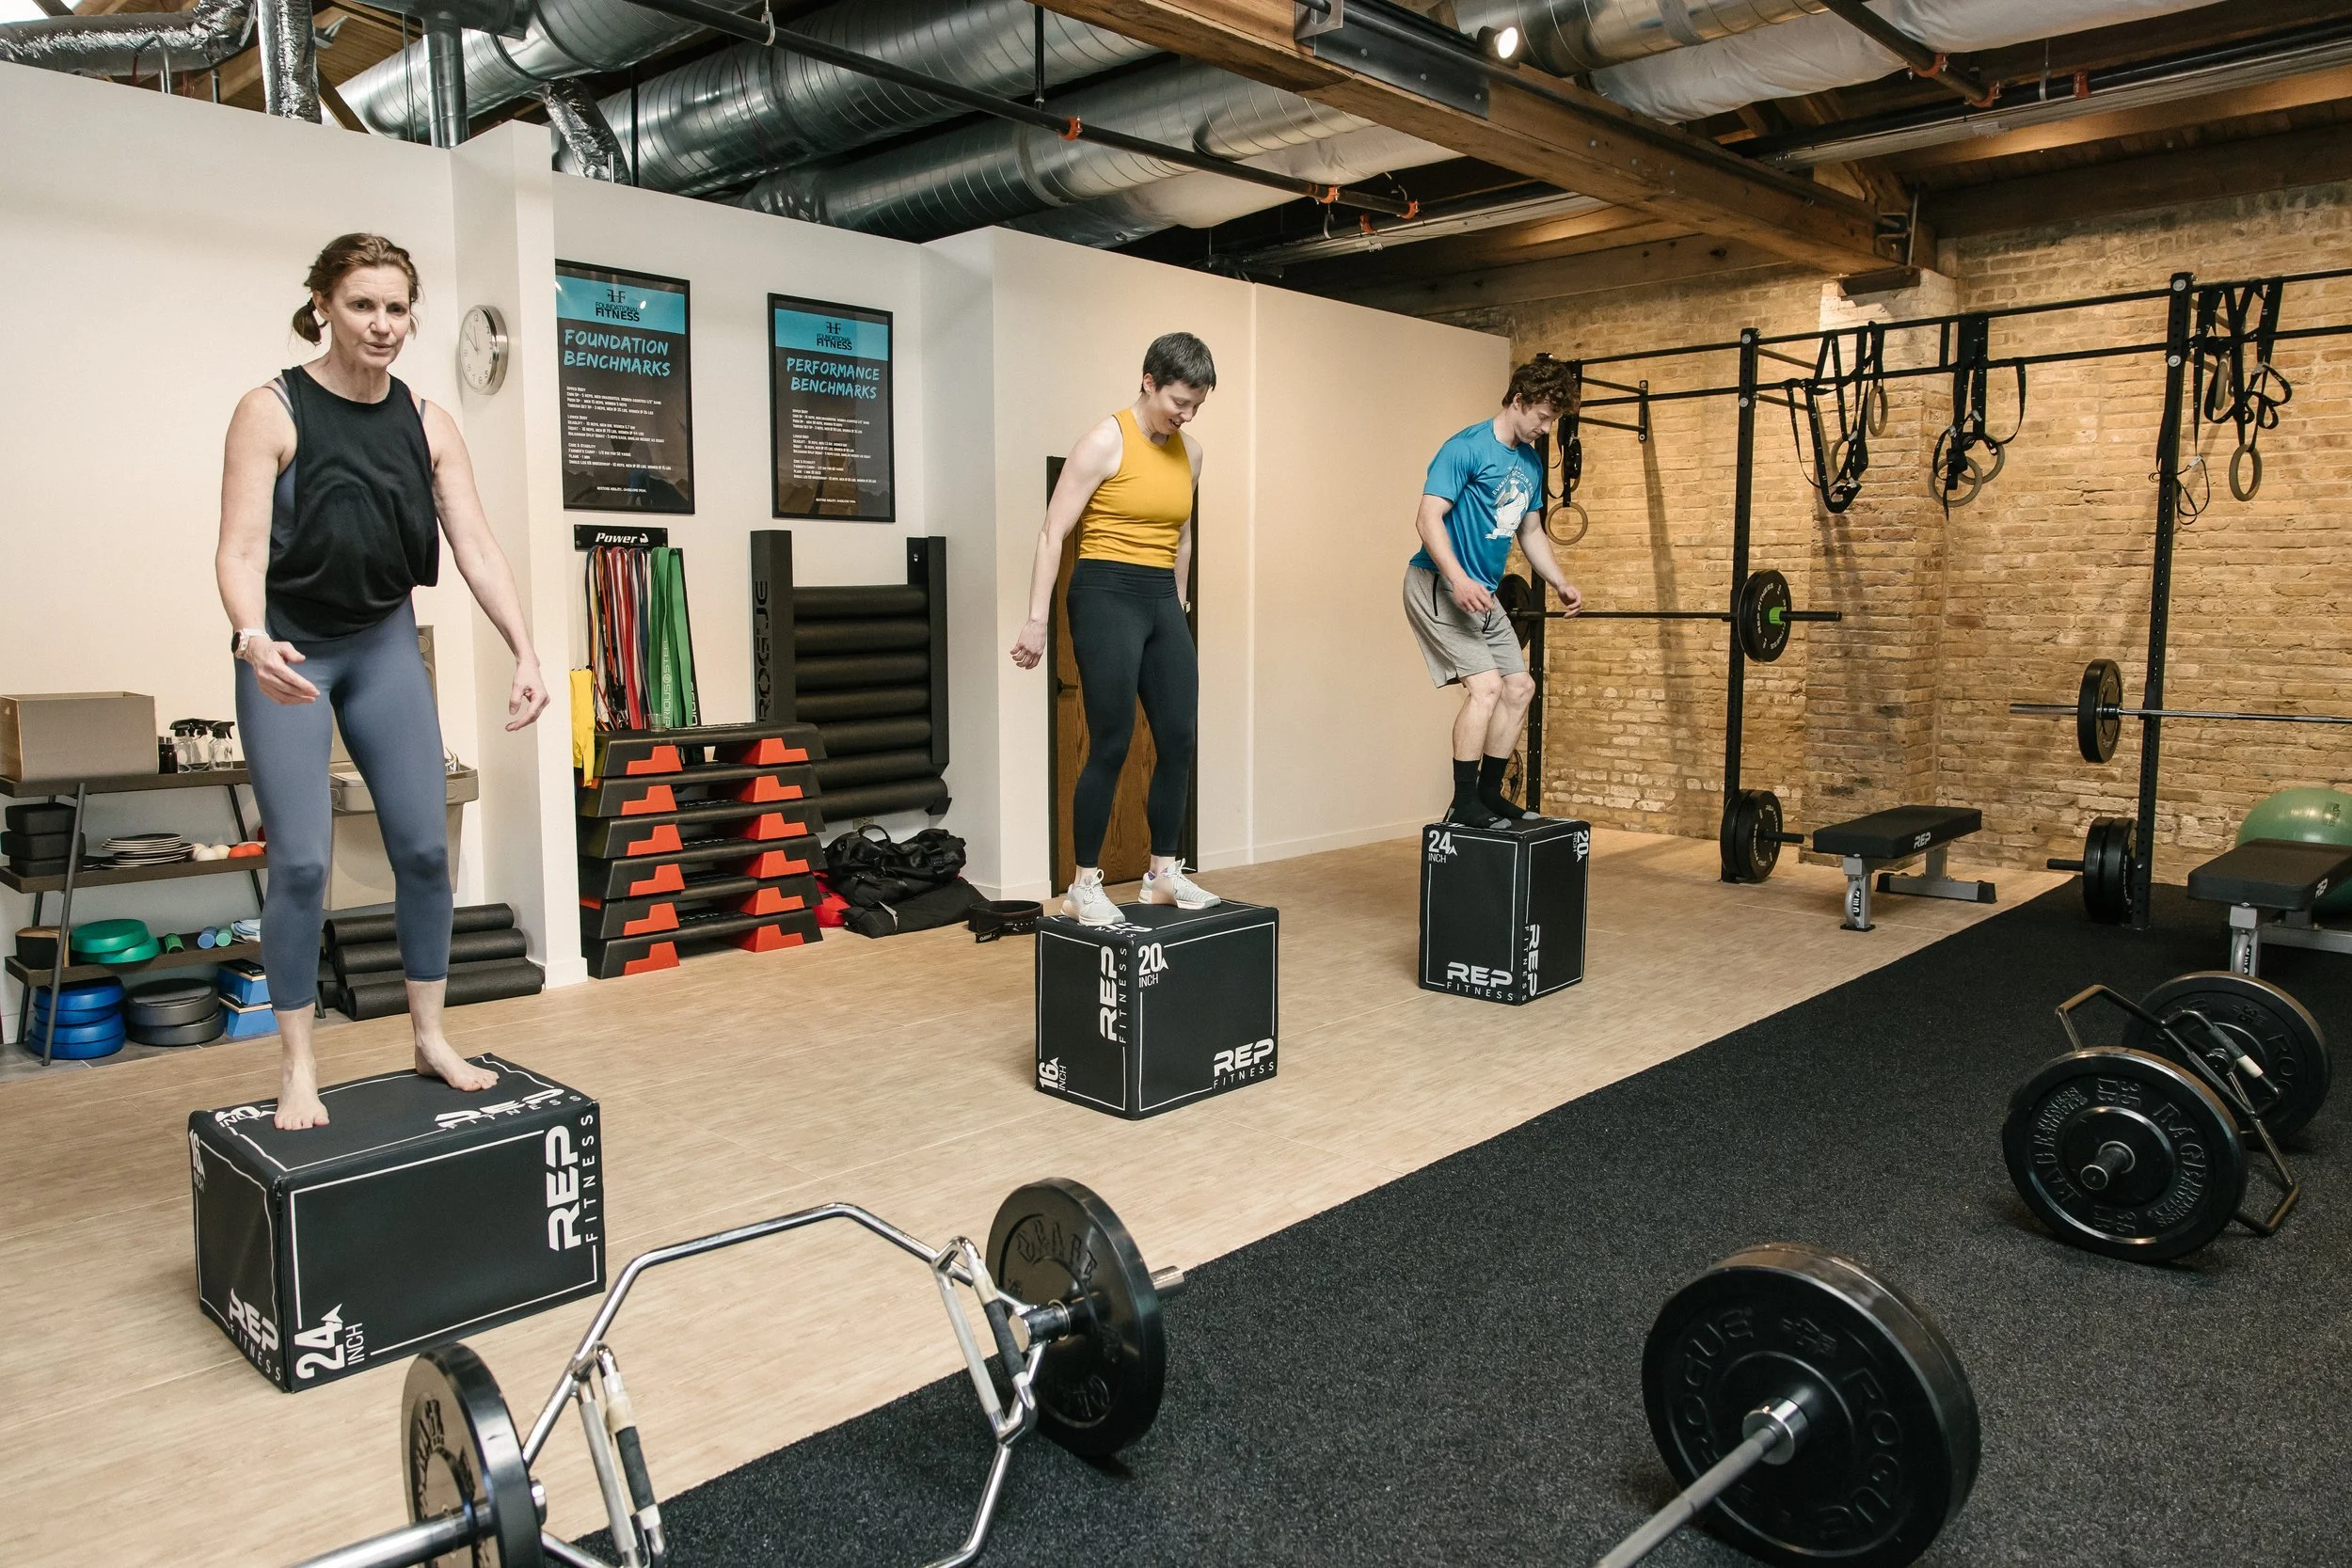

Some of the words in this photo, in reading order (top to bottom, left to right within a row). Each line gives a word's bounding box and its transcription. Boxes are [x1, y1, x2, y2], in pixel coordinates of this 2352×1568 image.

[596, 301, 638, 312] FOUNDATIONAL
[596, 308, 640, 322] FITNESS
[564, 329, 669, 356] FOUNDATION
[817, 339, 852, 351] FITNESS
[564, 350, 671, 377] BENCHMARKS
[787, 356, 880, 381] PERFORMANCE
[791, 376, 877, 400] BENCHMARKS
[595, 532, 638, 543] Power
[755, 580, 771, 722] ROGUE
[1428, 830, 1452, 854] 24
[1576, 830, 1589, 856] 20
[1914, 832, 1931, 849] REP
[1428, 852, 1447, 863] INCH
[1138, 942, 1163, 975] 20
[1521, 926, 1530, 1001] FITNESS
[1528, 924, 1540, 997] REP
[1138, 973, 1158, 988] INCH
[1447, 961, 1513, 988] REP
[1099, 945, 1118, 1041] REP
[1119, 947, 1128, 1044] FITNESS
[1446, 981, 1514, 1001] FITNESS
[1214, 1037, 1274, 1077] REP
[1039, 1061, 1059, 1089] 16
[1057, 1065, 1067, 1091] INCH
[1213, 1061, 1274, 1089] FITNESS
[434, 1088, 564, 1128] REP
[545, 1125, 581, 1251] REP
[580, 1114, 598, 1243] FITNESS
[229, 1288, 278, 1352] REP
[230, 1323, 281, 1382] FITNESS
[294, 1321, 345, 1379] 24
[345, 1323, 365, 1366] INCH
